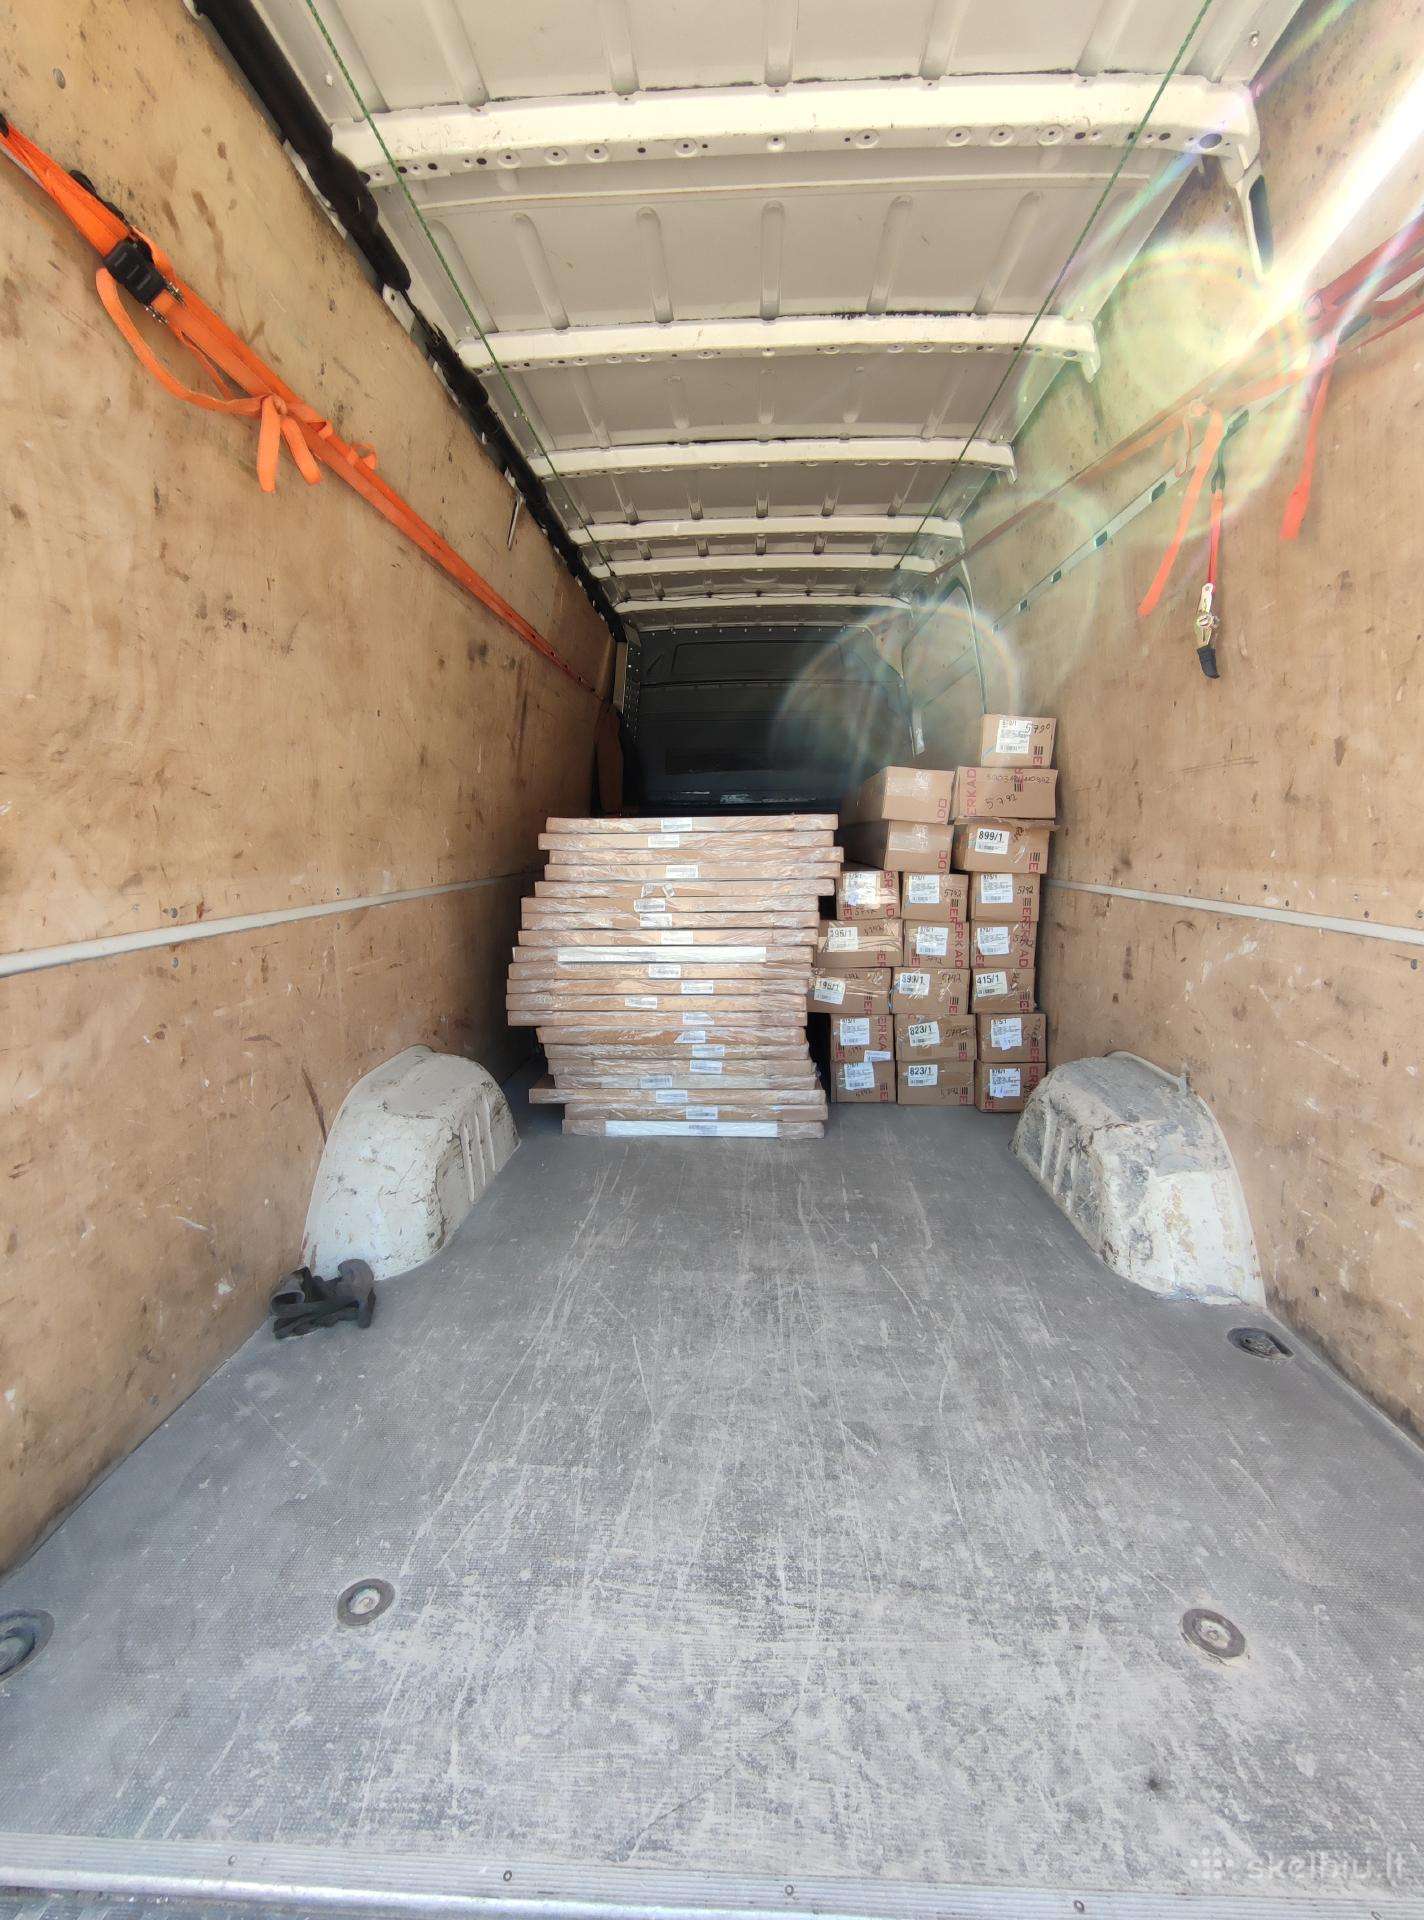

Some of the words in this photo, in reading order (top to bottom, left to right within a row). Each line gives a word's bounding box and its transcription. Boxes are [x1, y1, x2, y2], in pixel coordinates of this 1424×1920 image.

[978, 831, 1003, 843] 899/1
[976, 974, 999, 984] 415/1
[909, 1024, 932, 1036] 823/1
[909, 1067, 932, 1076] 823/1
